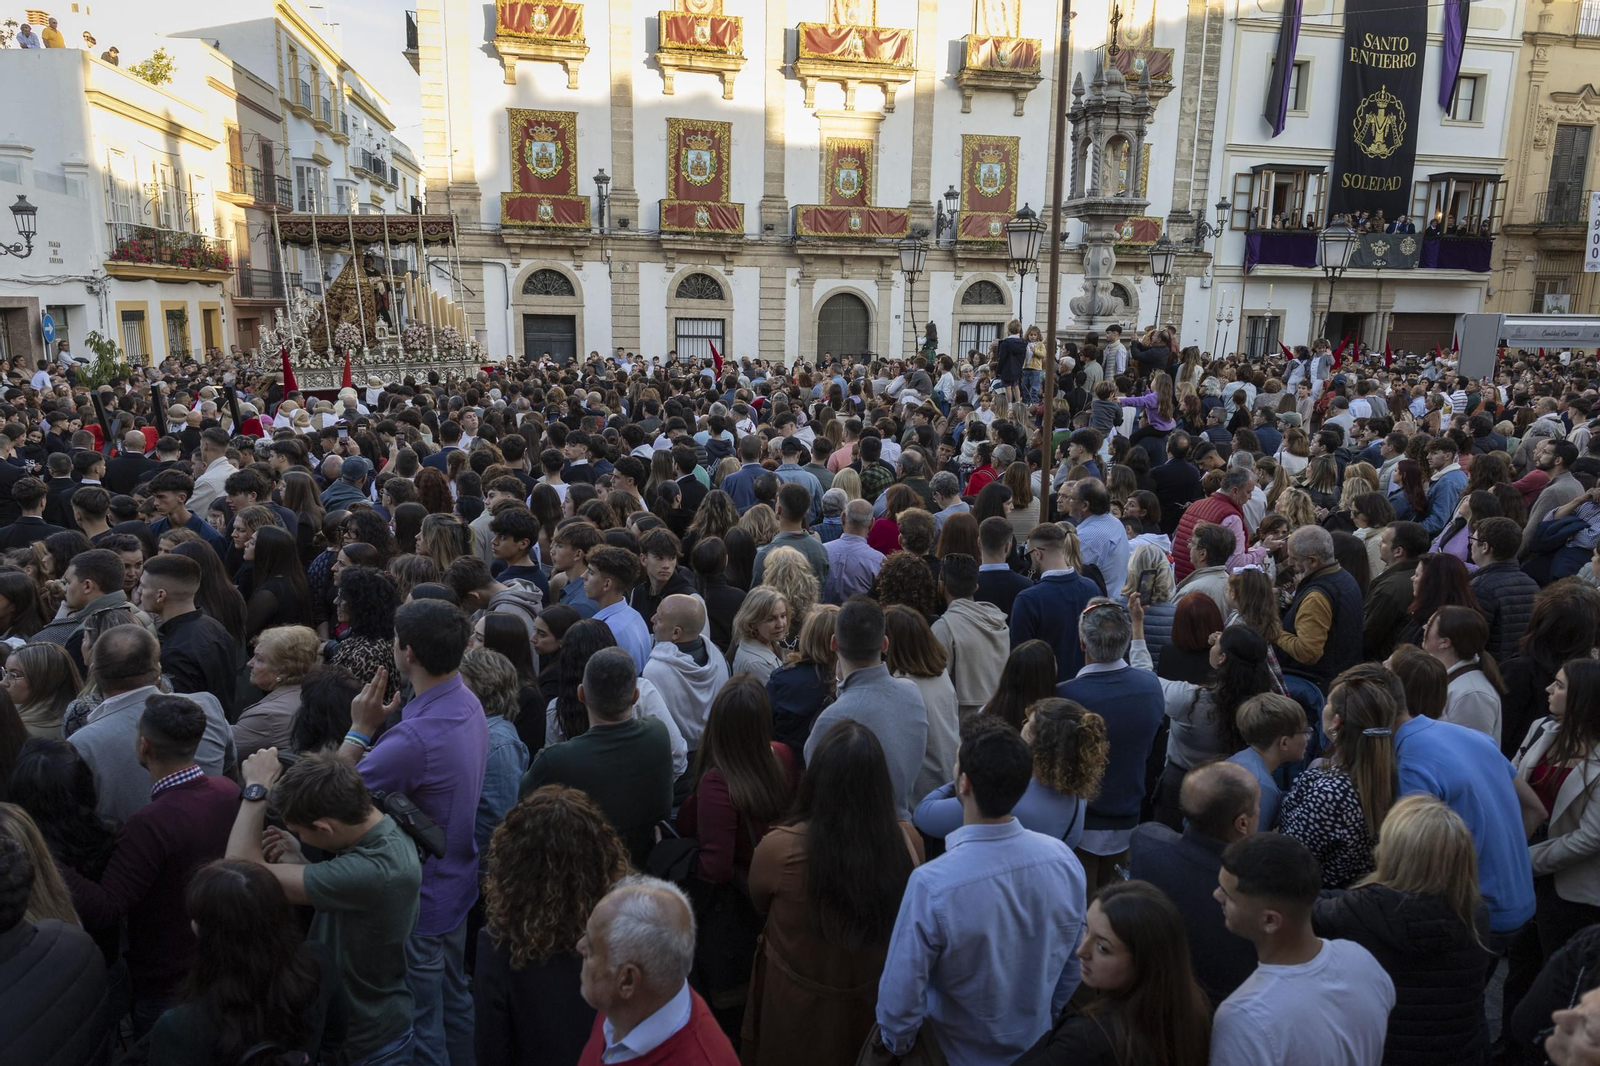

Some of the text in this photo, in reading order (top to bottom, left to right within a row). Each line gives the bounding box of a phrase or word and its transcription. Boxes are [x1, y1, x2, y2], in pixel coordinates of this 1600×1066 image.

[1363, 32, 1409, 52] SANTO
[1349, 46, 1417, 69] ENTIERRO
[1342, 172, 1401, 191] SOLEDAD
